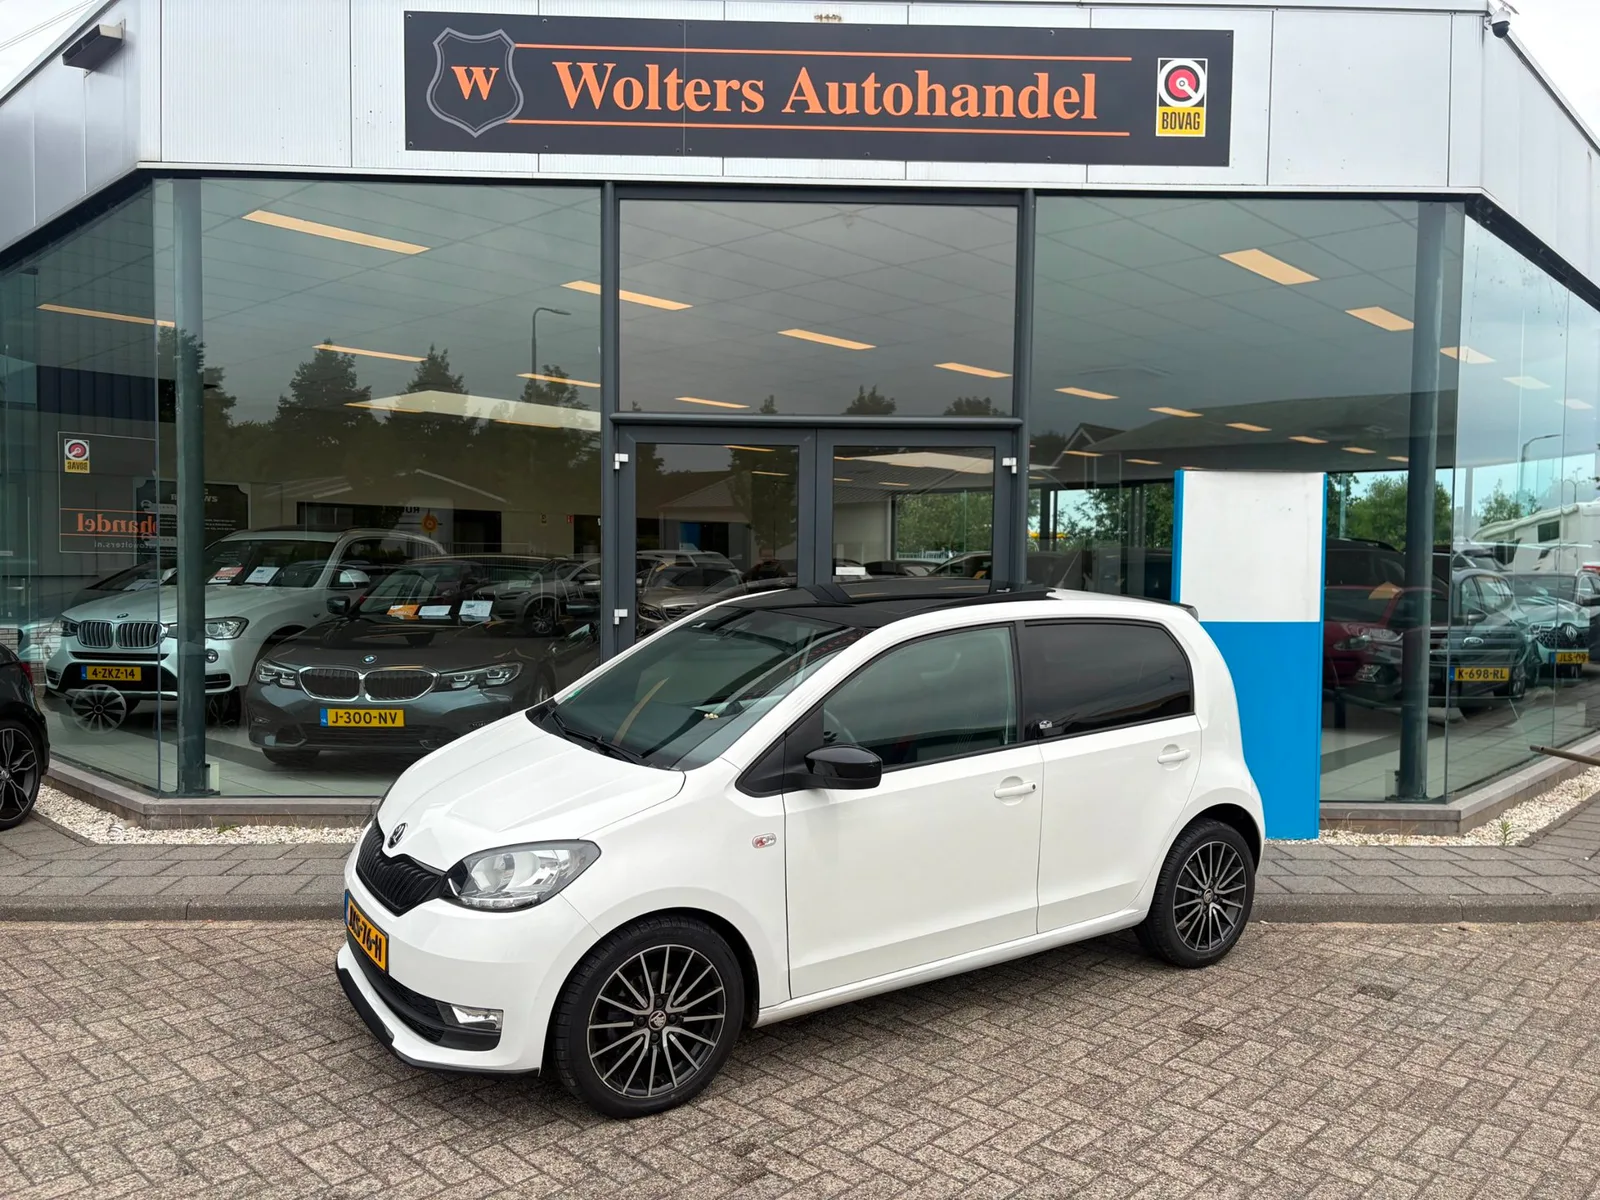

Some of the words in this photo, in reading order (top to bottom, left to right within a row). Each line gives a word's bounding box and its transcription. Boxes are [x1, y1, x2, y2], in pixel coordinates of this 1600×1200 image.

[451, 65, 499, 101] W
[552, 61, 765, 113] Wolters
[782, 66, 1098, 120] Autohandel
[1161, 110, 1200, 131] BOVAG
[92, 667, 136, 679] 4-ZKZ-14
[1458, 668, 1506, 680] K-698-RL
[332, 711, 398, 724] J-300-NV
